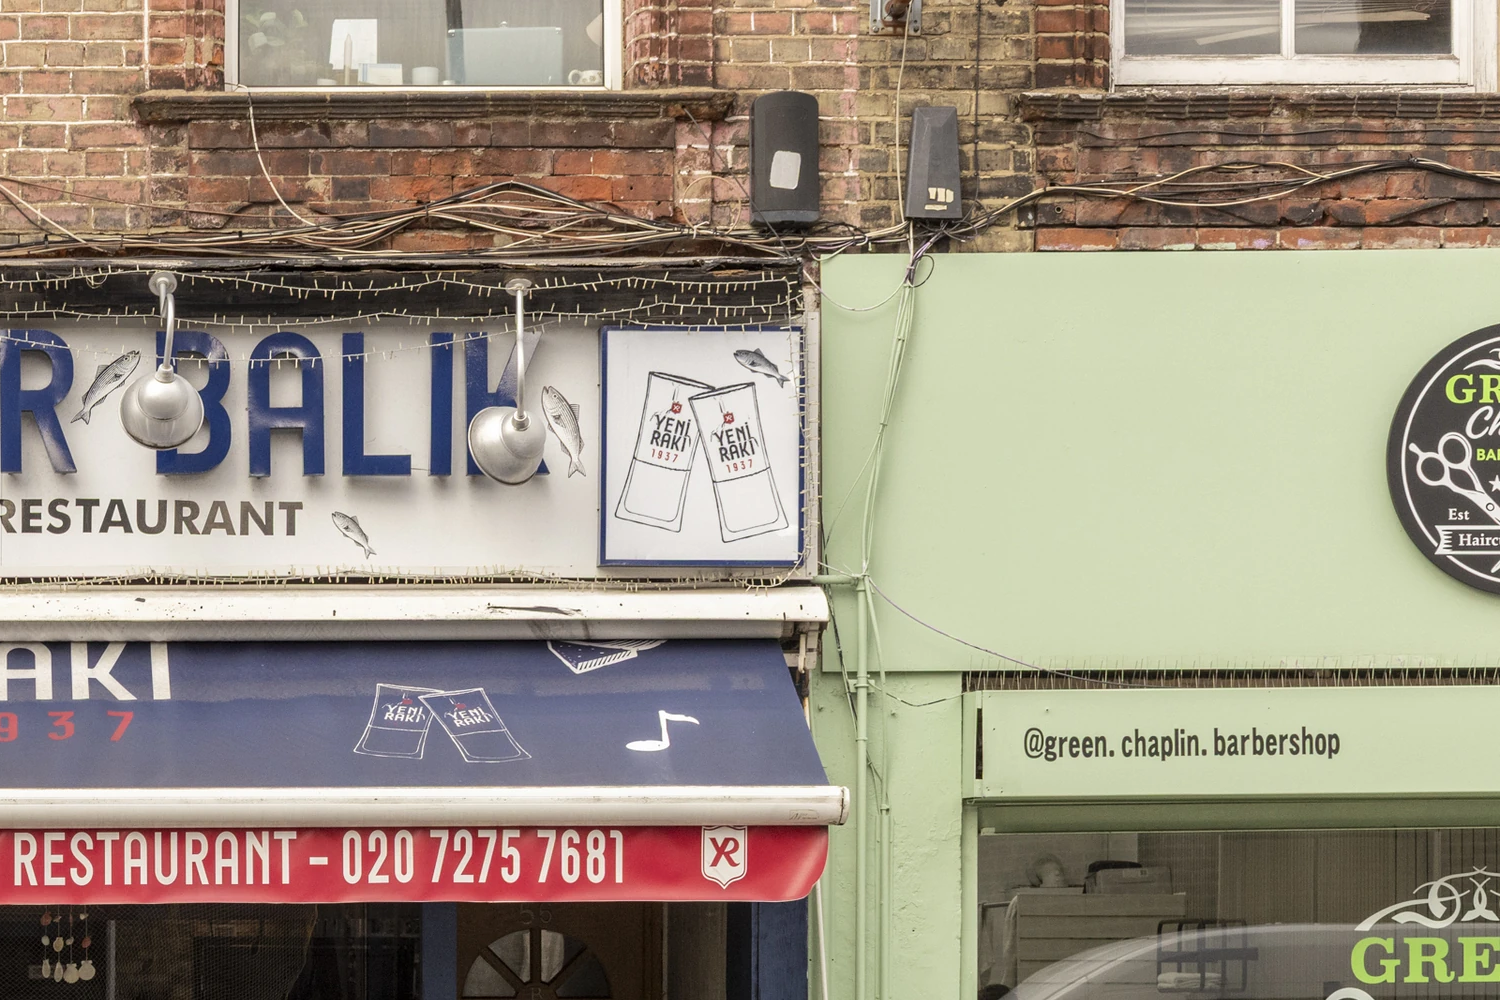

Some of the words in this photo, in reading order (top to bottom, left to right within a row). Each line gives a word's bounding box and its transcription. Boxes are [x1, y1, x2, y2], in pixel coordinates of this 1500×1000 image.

[155, 331, 551, 478] BALIK
[650, 430, 687, 452] RAKI
[652, 448, 679, 463] 1937
[718, 440, 756, 462] RAKI
[726, 458, 753, 473] 1937
[1448, 508, 1470, 521] Est
[1458, 533, 1500, 547] Hairc
[384, 713, 420, 723] RAKI
[453, 714, 491, 728] RAKI
[1121, 728, 1208, 762] chaplin.
[1213, 726, 1341, 759] barbershop
[14, 830, 297, 887] RESTAURANT
[342, 829, 413, 885] 020
[430, 829, 521, 884] 7275
[537, 829, 625, 884] 7681
[1350, 936, 1500, 985] GRE
